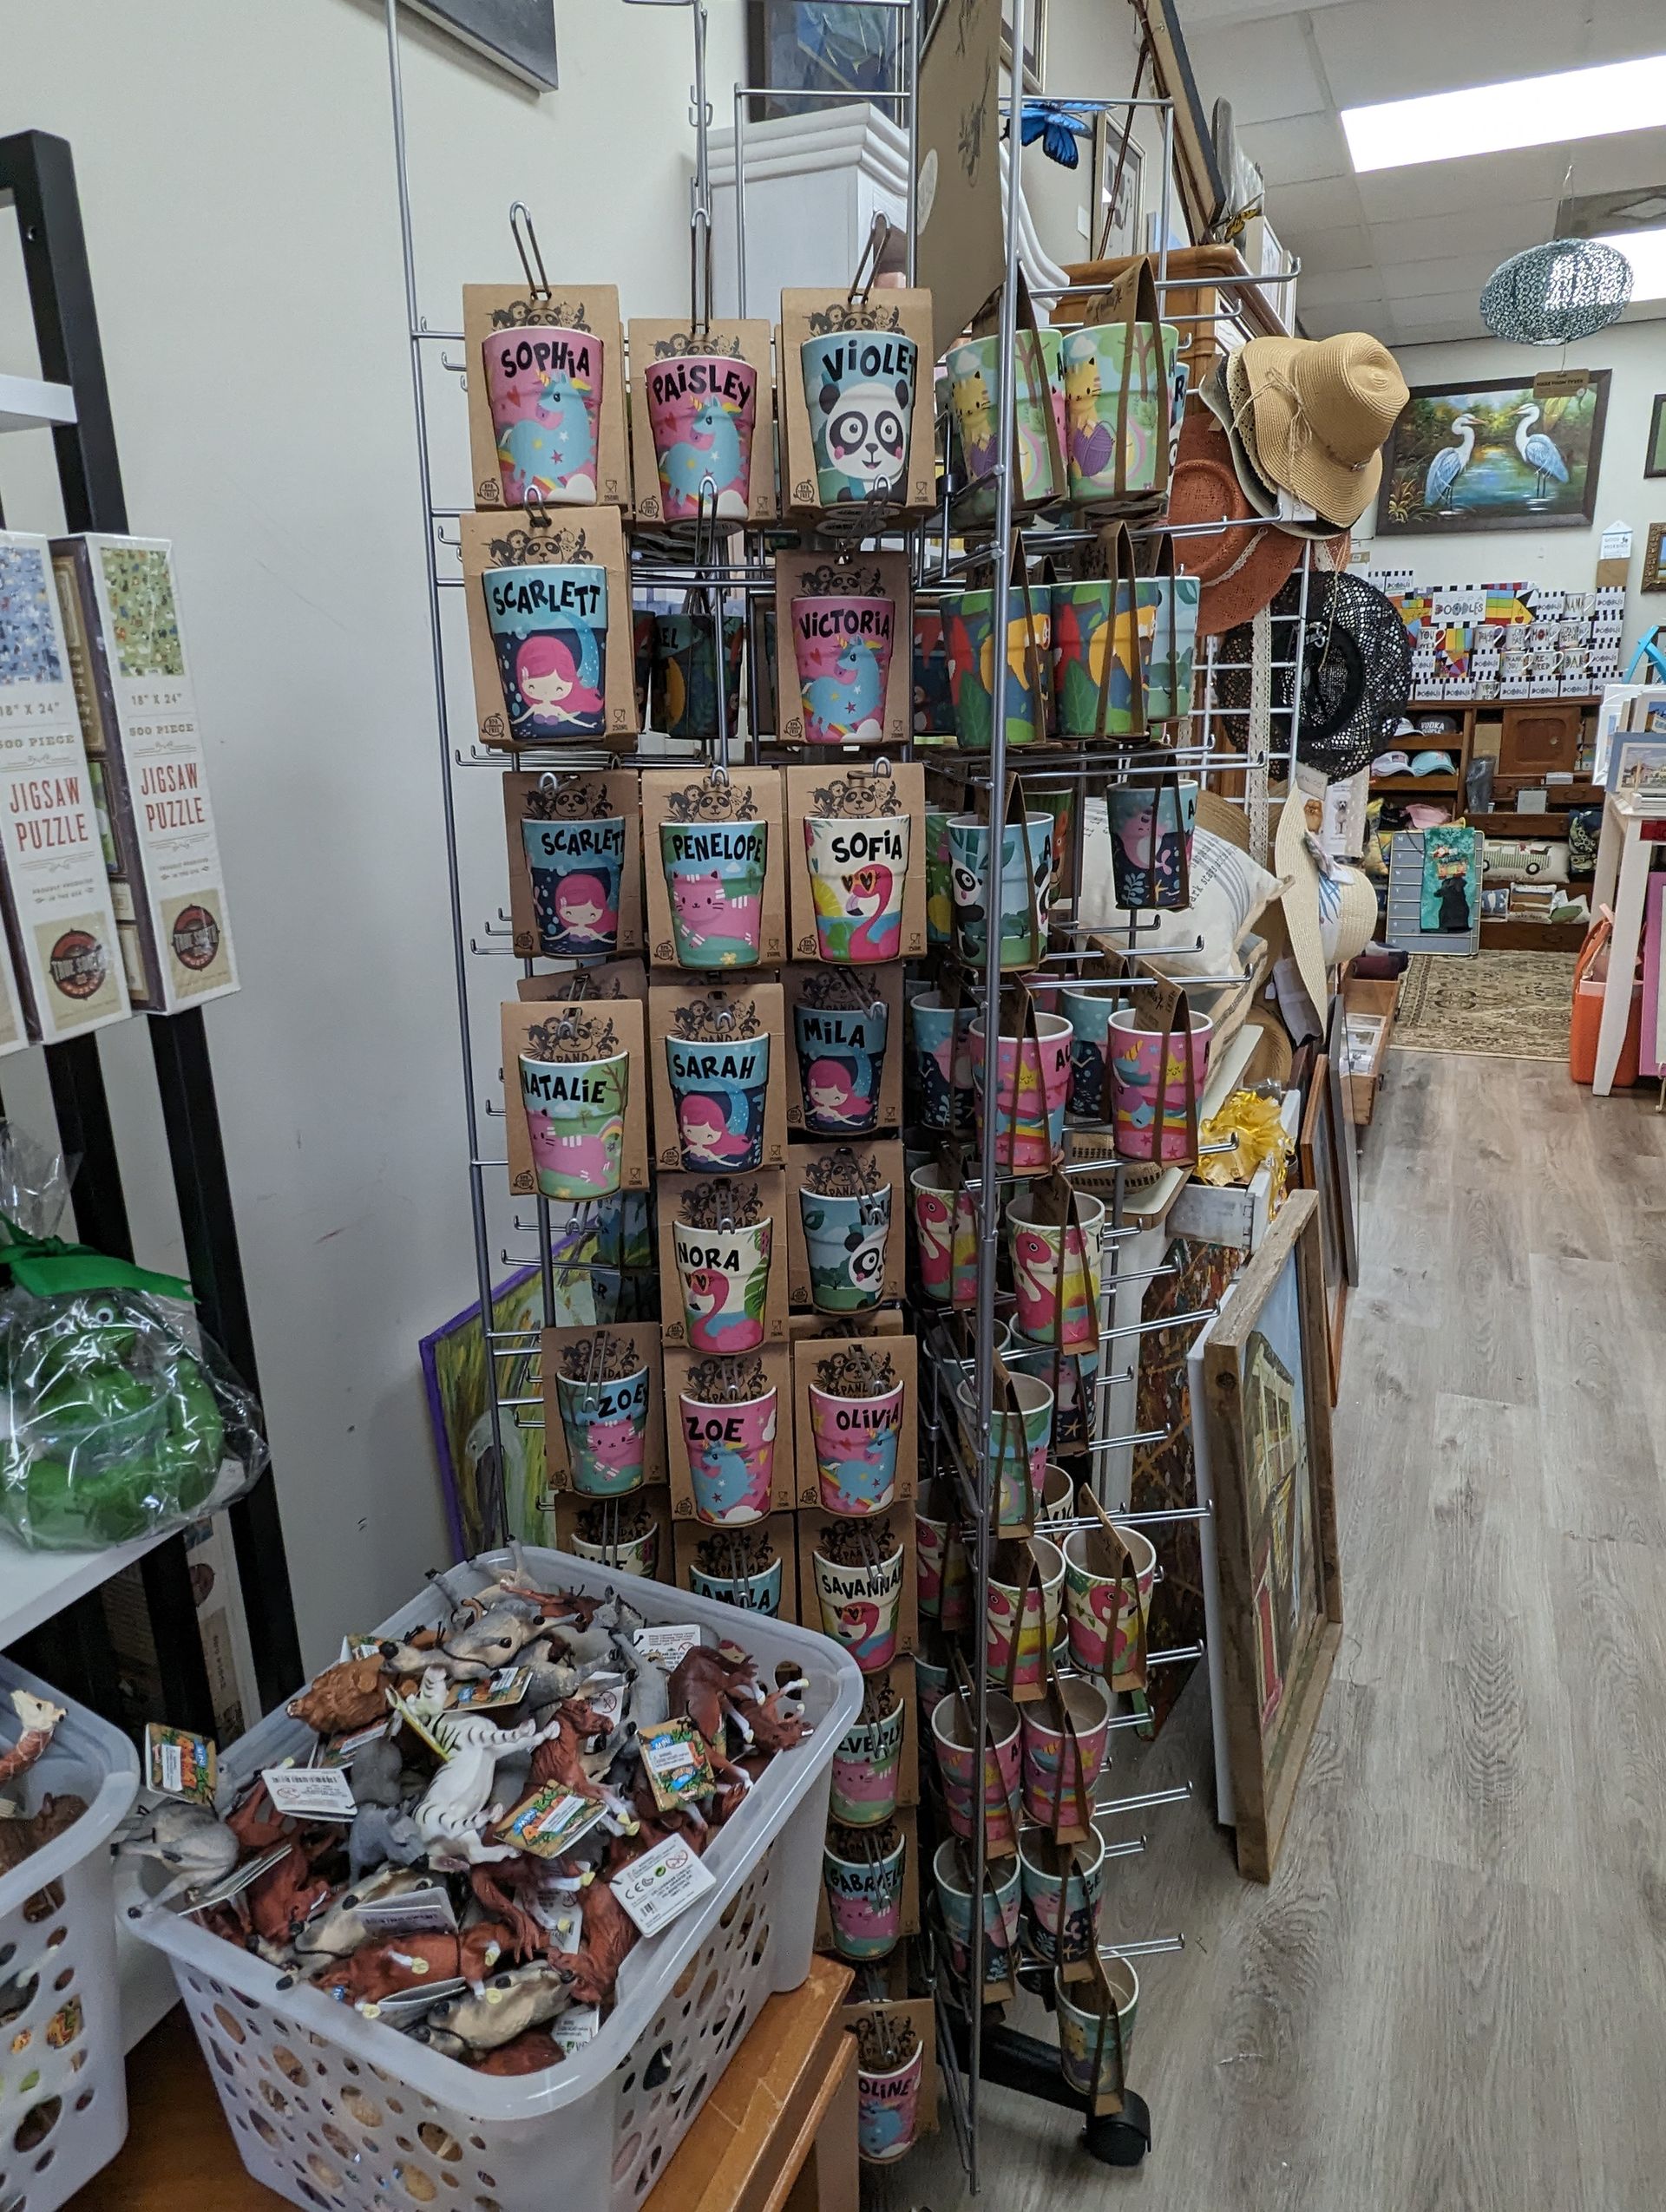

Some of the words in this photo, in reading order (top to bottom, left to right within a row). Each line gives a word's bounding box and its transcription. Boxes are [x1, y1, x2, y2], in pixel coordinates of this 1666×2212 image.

[493, 579, 601, 617] SCARLETT
[1434, 602, 1484, 617] DOODLES
[29, 735, 75, 748] PIECE
[155, 723, 194, 735] PIECE
[1420, 722, 1445, 730] VODKA
[141, 762, 199, 795] JIGSAW
[10, 776, 82, 814] JIGSAW
[146, 797, 206, 831] PUZZLE
[15, 814, 89, 852] PUZZLE
[672, 832, 762, 865] PENELOPE
[672, 1054, 756, 1079] SARAH
[678, 1241, 740, 1273] NORA
[685, 1416, 744, 1443] ZOE
